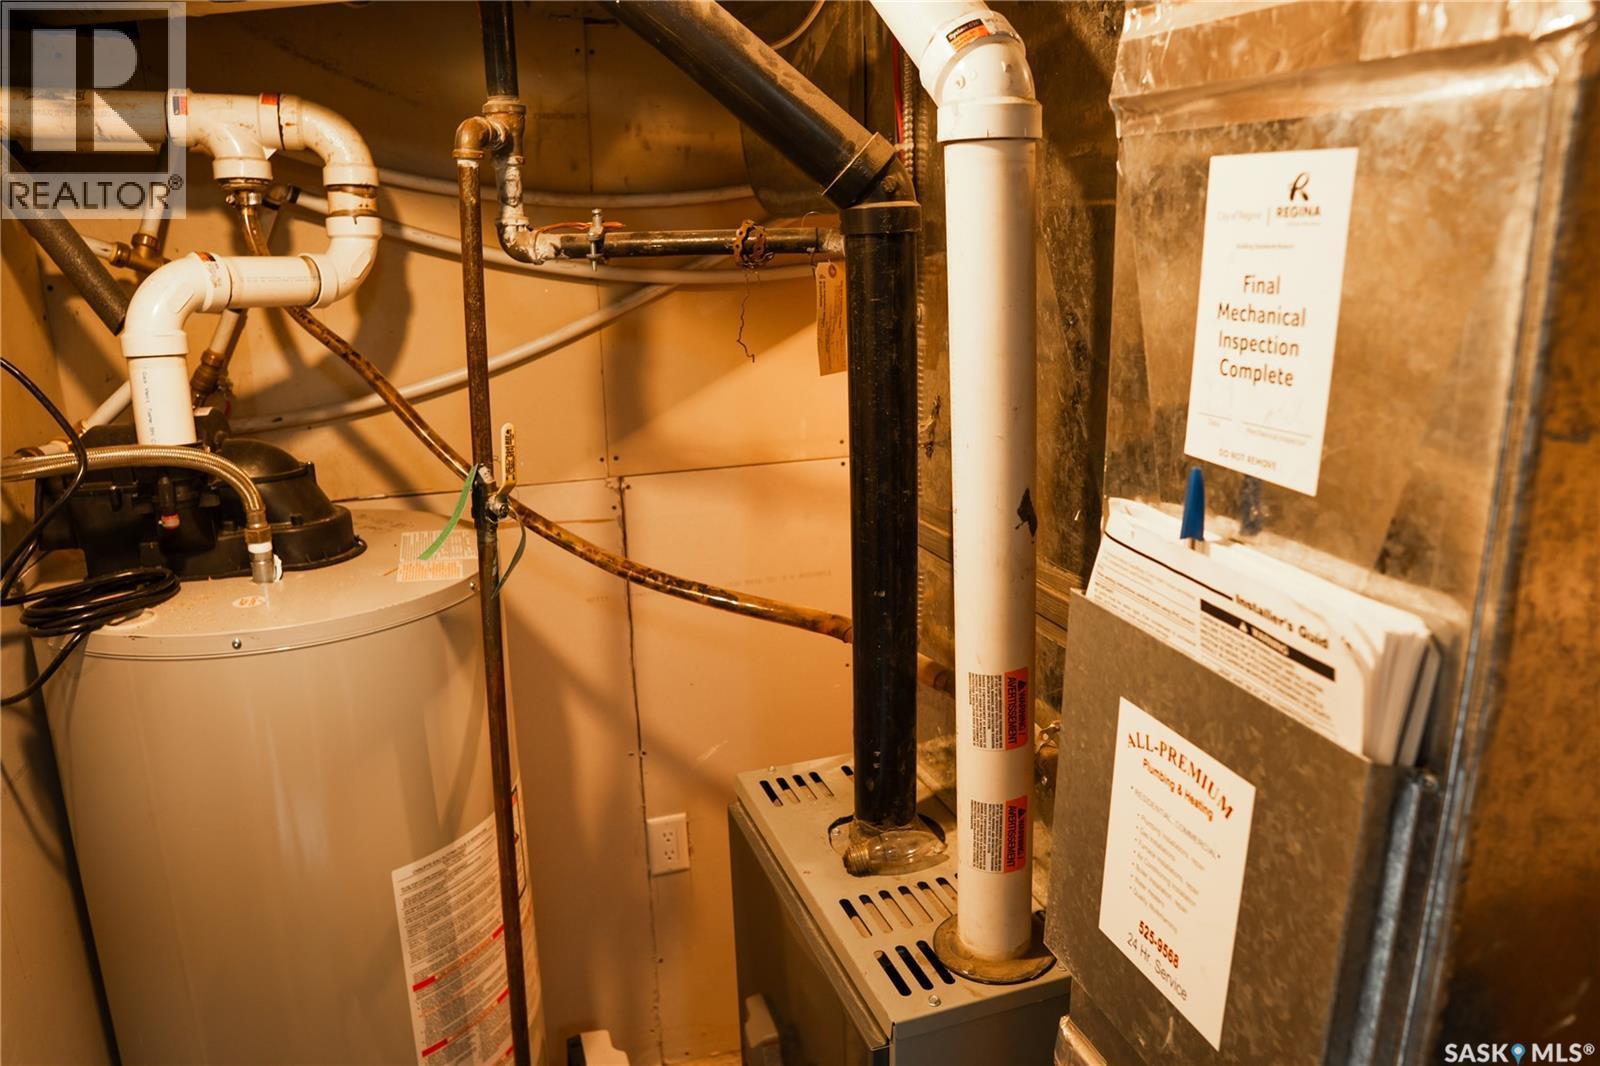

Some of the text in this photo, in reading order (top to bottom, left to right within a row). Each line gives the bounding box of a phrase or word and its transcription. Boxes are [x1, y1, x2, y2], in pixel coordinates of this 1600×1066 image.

[1276, 205, 1322, 218] REGINA
[1243, 275, 1281, 295] Final
[1217, 302, 1307, 327] Mechanical
[1218, 331, 1301, 357] Inspection
[1219, 358, 1295, 387] Complete
[1236, 594, 1293, 632] Installer's
[1007, 677, 1017, 744] AVERTISSEMENT
[1127, 731, 1235, 819] ALL-PREMIUM
[1142, 758, 1176, 793] Plumbing
[1184, 793, 1214, 823] Heating
[1138, 920, 1180, 969] 525-9568
[1127, 932, 1138, 951] 24
[1154, 960, 1188, 1001] Service
